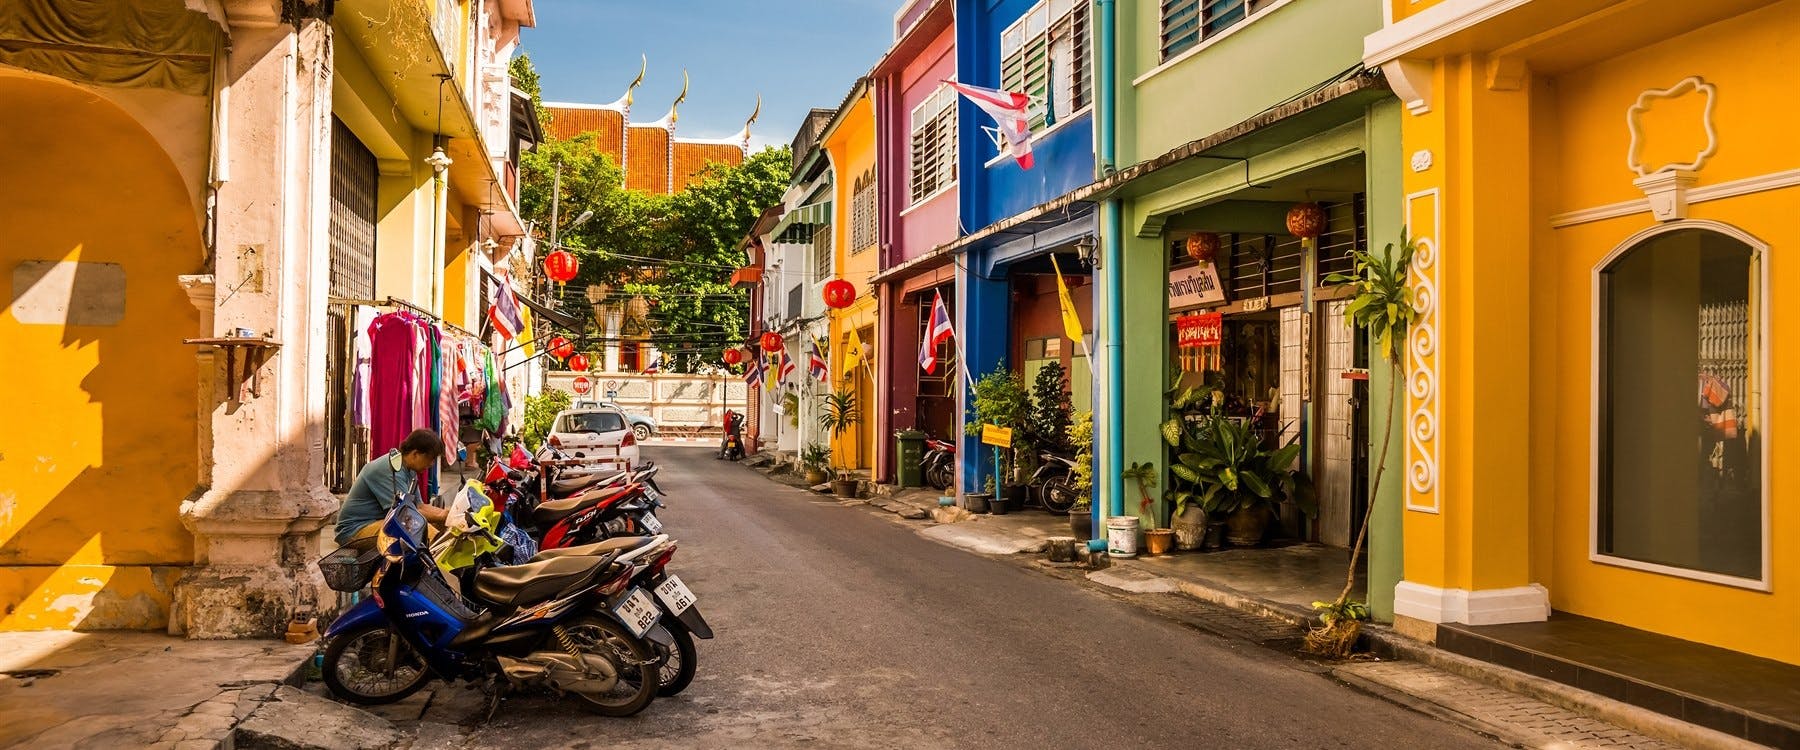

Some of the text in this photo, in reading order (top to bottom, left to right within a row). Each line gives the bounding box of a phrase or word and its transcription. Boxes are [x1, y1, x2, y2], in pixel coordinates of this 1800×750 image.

[675, 595, 691, 611] 461
[405, 610, 429, 618] HONDA
[637, 611, 655, 630] 822
